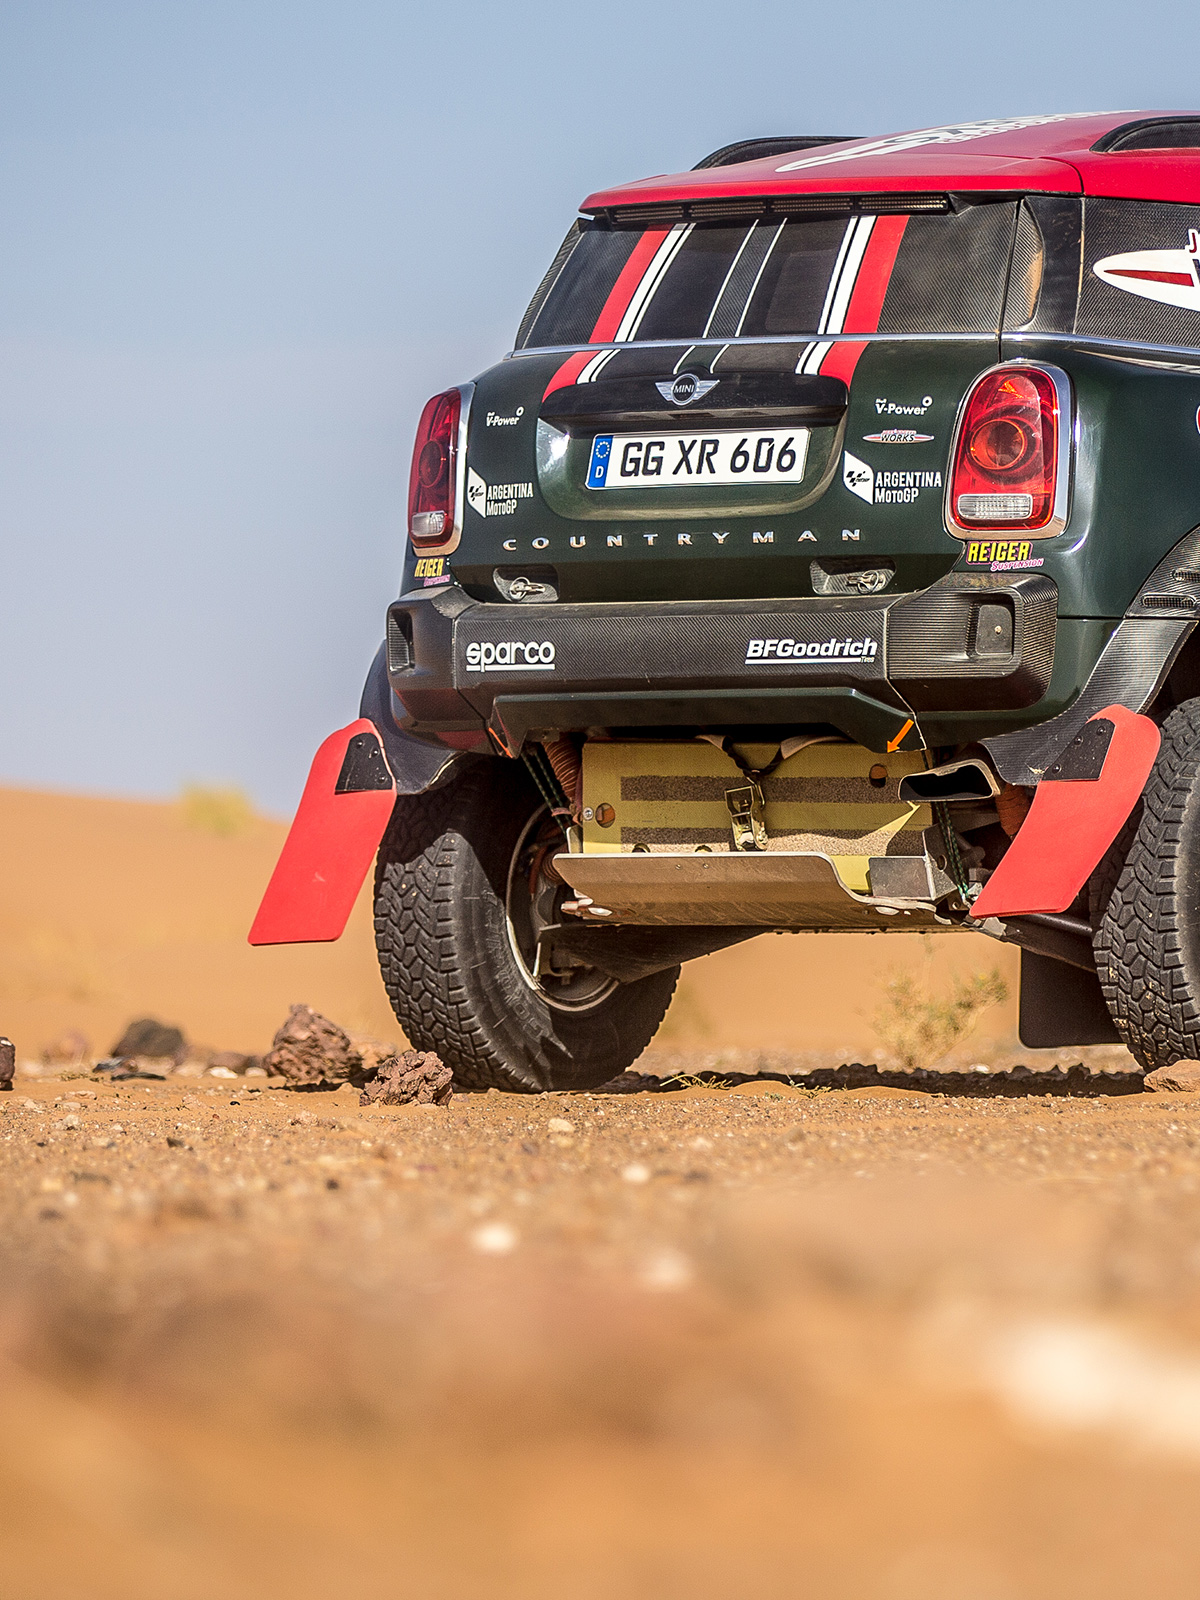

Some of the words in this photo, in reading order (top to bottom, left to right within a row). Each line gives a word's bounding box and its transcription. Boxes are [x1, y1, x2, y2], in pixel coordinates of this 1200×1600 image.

[674, 384, 695, 394] MINI
[875, 403, 928, 415] V-Power
[881, 434, 915, 442] WORKS
[620, 441, 665, 477] GG
[672, 439, 720, 475] XR
[730, 437, 797, 473] 606
[595, 465, 604, 479] D
[875, 471, 942, 487] ARGENTINA
[487, 482, 534, 500] ARGENTINA
[502, 528, 861, 551] COUNTRYMAN
[967, 542, 1030, 562] REIGER
[414, 558, 444, 577] REIGER
[466, 641, 555, 671] sparco
[746, 638, 878, 658] BFGoodrich
